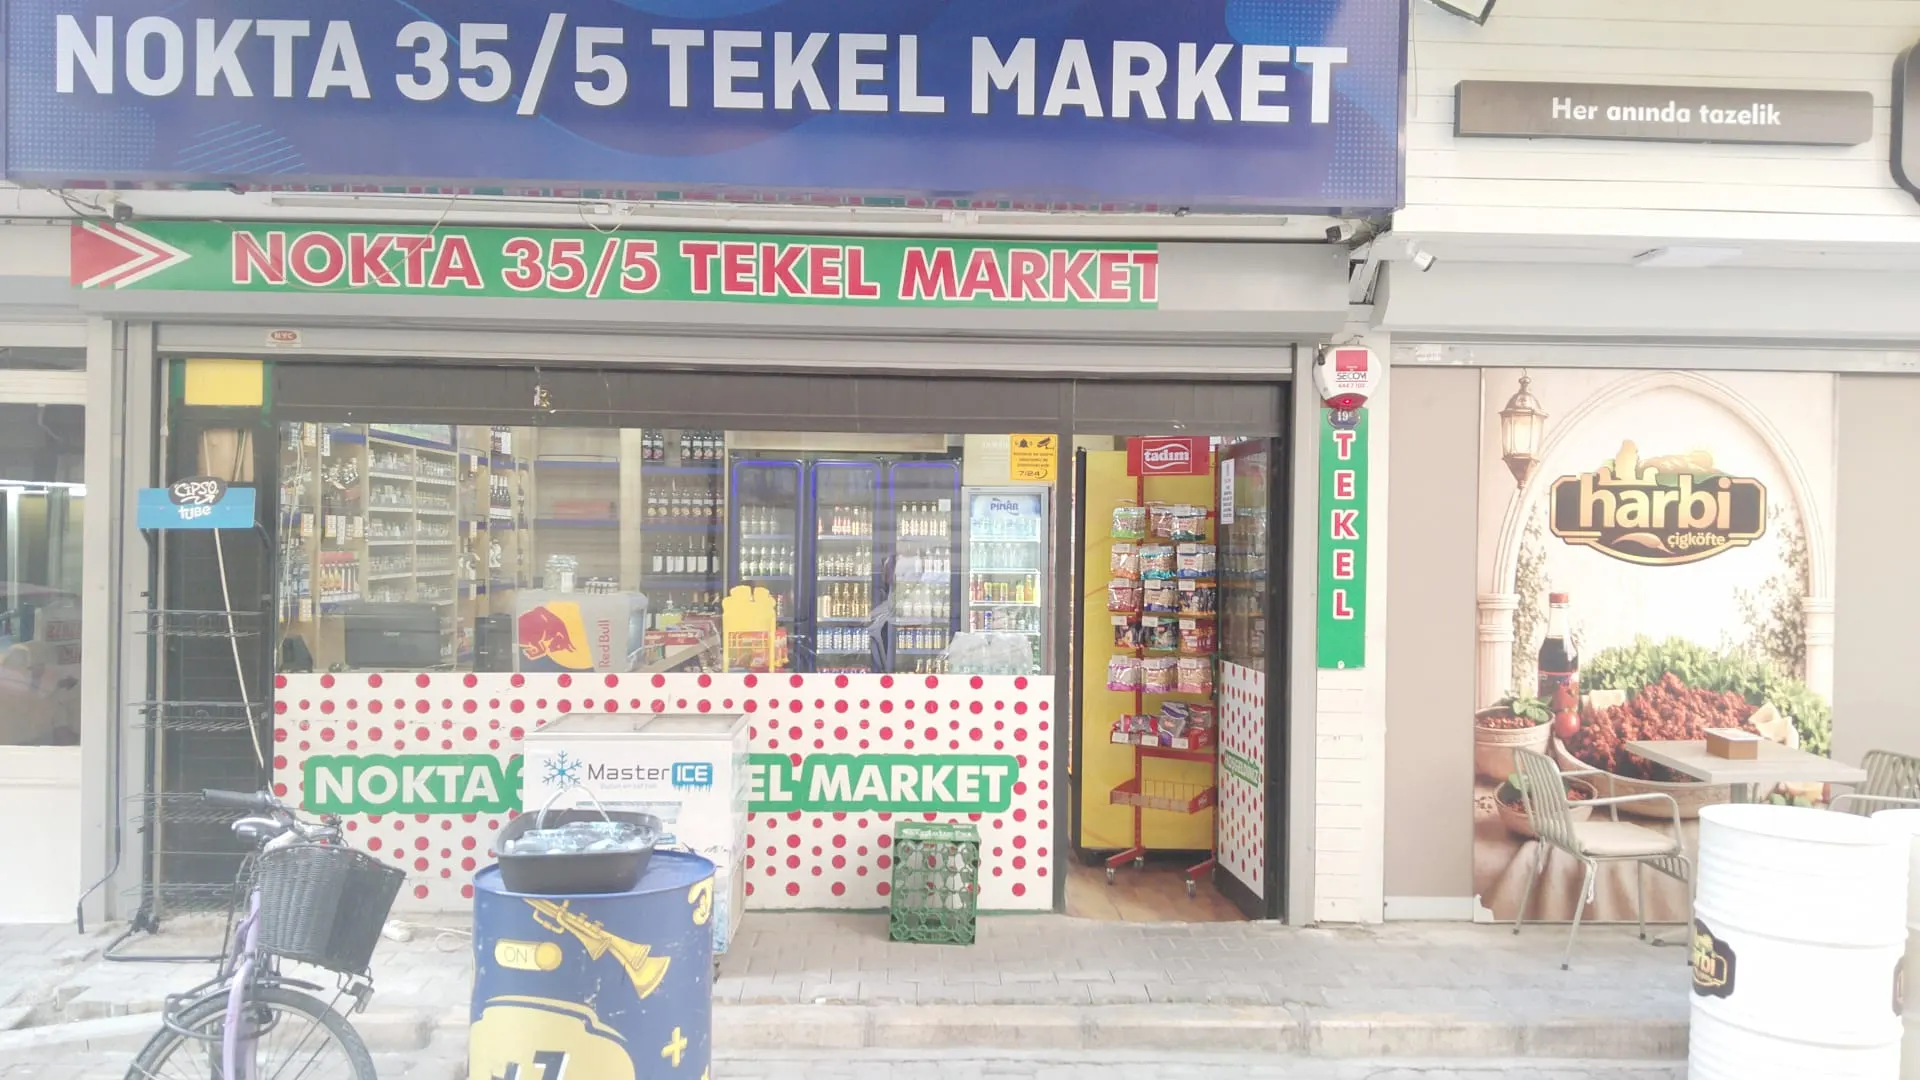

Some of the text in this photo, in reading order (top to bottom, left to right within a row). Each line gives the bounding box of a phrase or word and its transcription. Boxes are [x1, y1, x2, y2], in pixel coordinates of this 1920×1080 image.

[55, 13, 1348, 124] NOKTA 35/5 TEKEL MARKET
[1552, 97, 1781, 125] Her anında tazelik
[231, 230, 1158, 303] NOKTA 35/5 TEKEL MARKET
[1336, 372, 1367, 380] SECOM
[1144, 449, 1190, 461] tadım
[1578, 472, 1733, 529] harbi
[1332, 430, 1358, 619] TEKEL
[598, 620, 610, 668] Red Bull
[315, 765, 501, 804] NOKTA
[588, 763, 708, 782] Master ICE
[808, 764, 1008, 803] MARKET
[504, 946, 528, 964] ON
